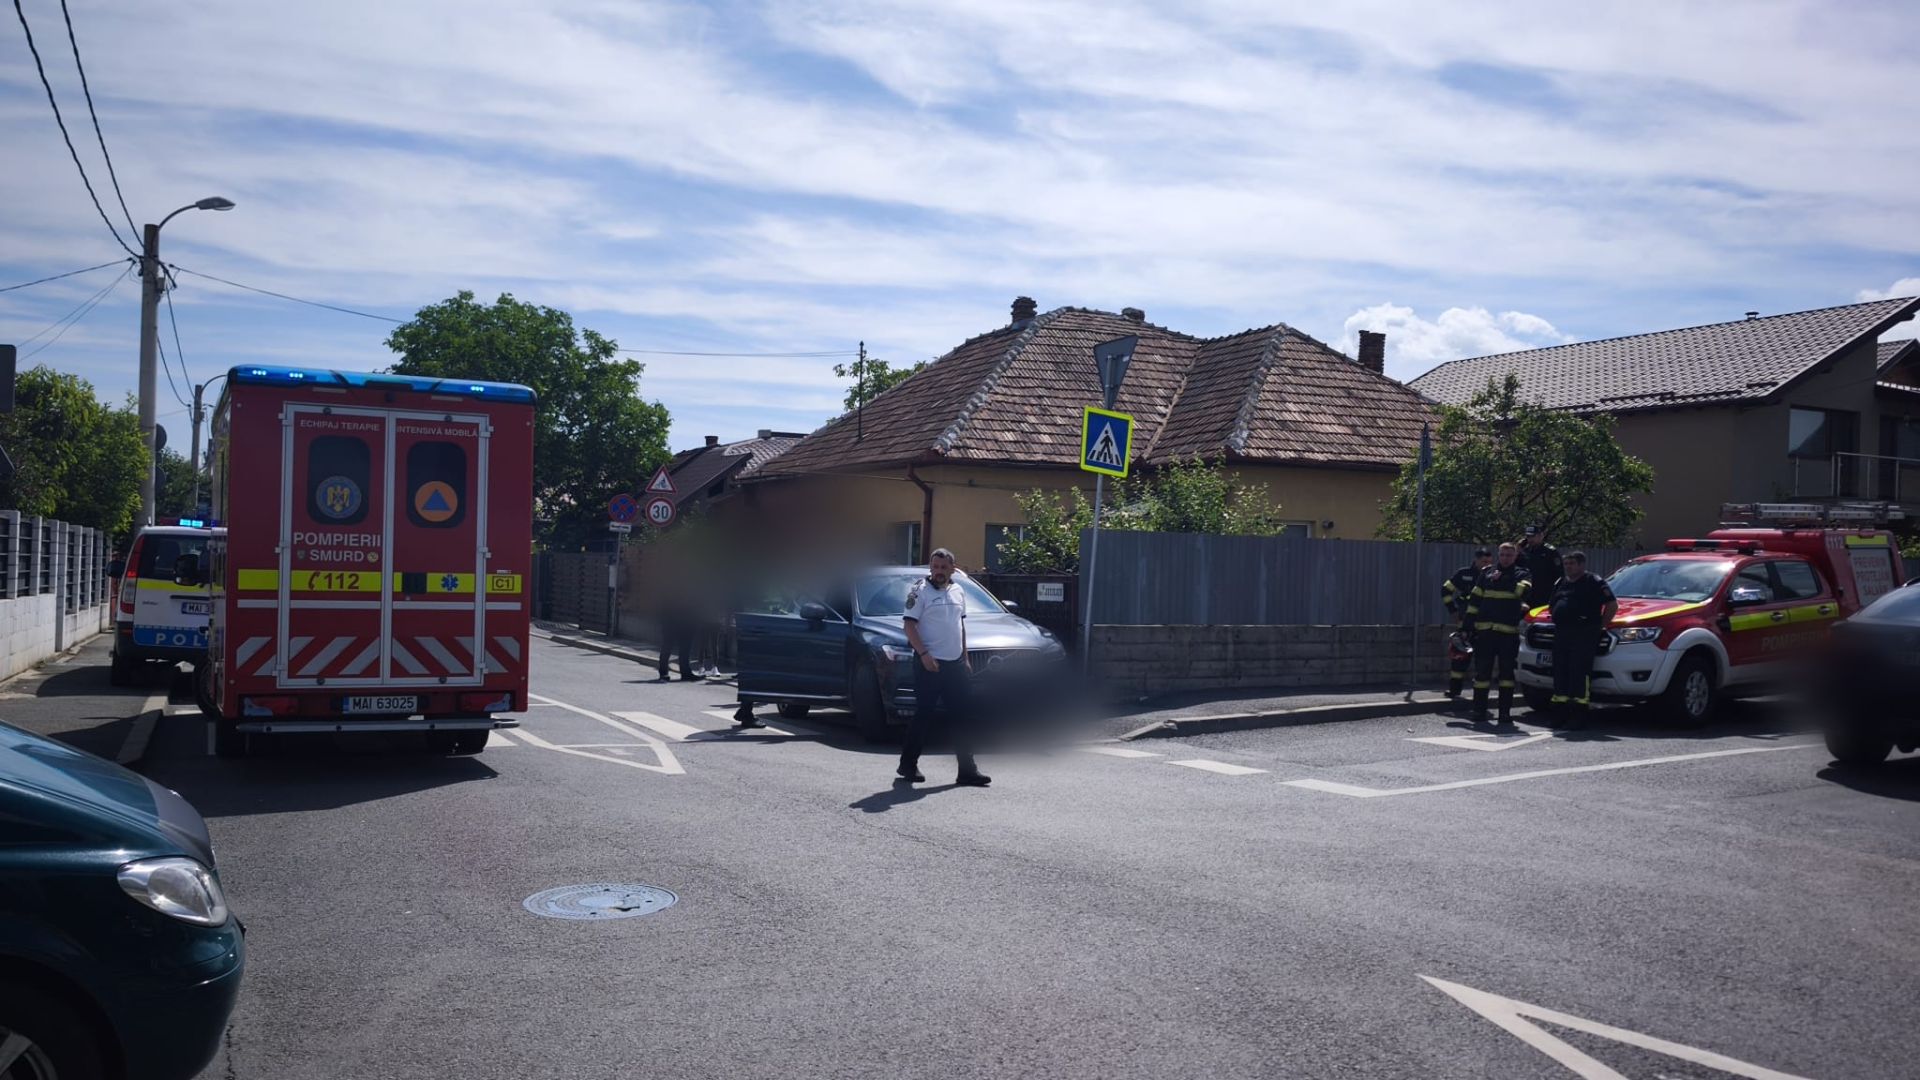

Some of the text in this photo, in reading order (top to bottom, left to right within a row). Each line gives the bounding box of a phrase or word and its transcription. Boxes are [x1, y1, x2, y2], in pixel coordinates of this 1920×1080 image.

[300, 419, 380, 432] ECHIPAJ TERAPIE
[652, 505, 668, 519] 30
[293, 532, 381, 548] POMPIERII
[309, 549, 364, 562] SMURD
[324, 572, 359, 590] 112
[495, 578, 510, 589] C1
[155, 632, 202, 646] POL
[353, 697, 414, 710] MAI 63025
